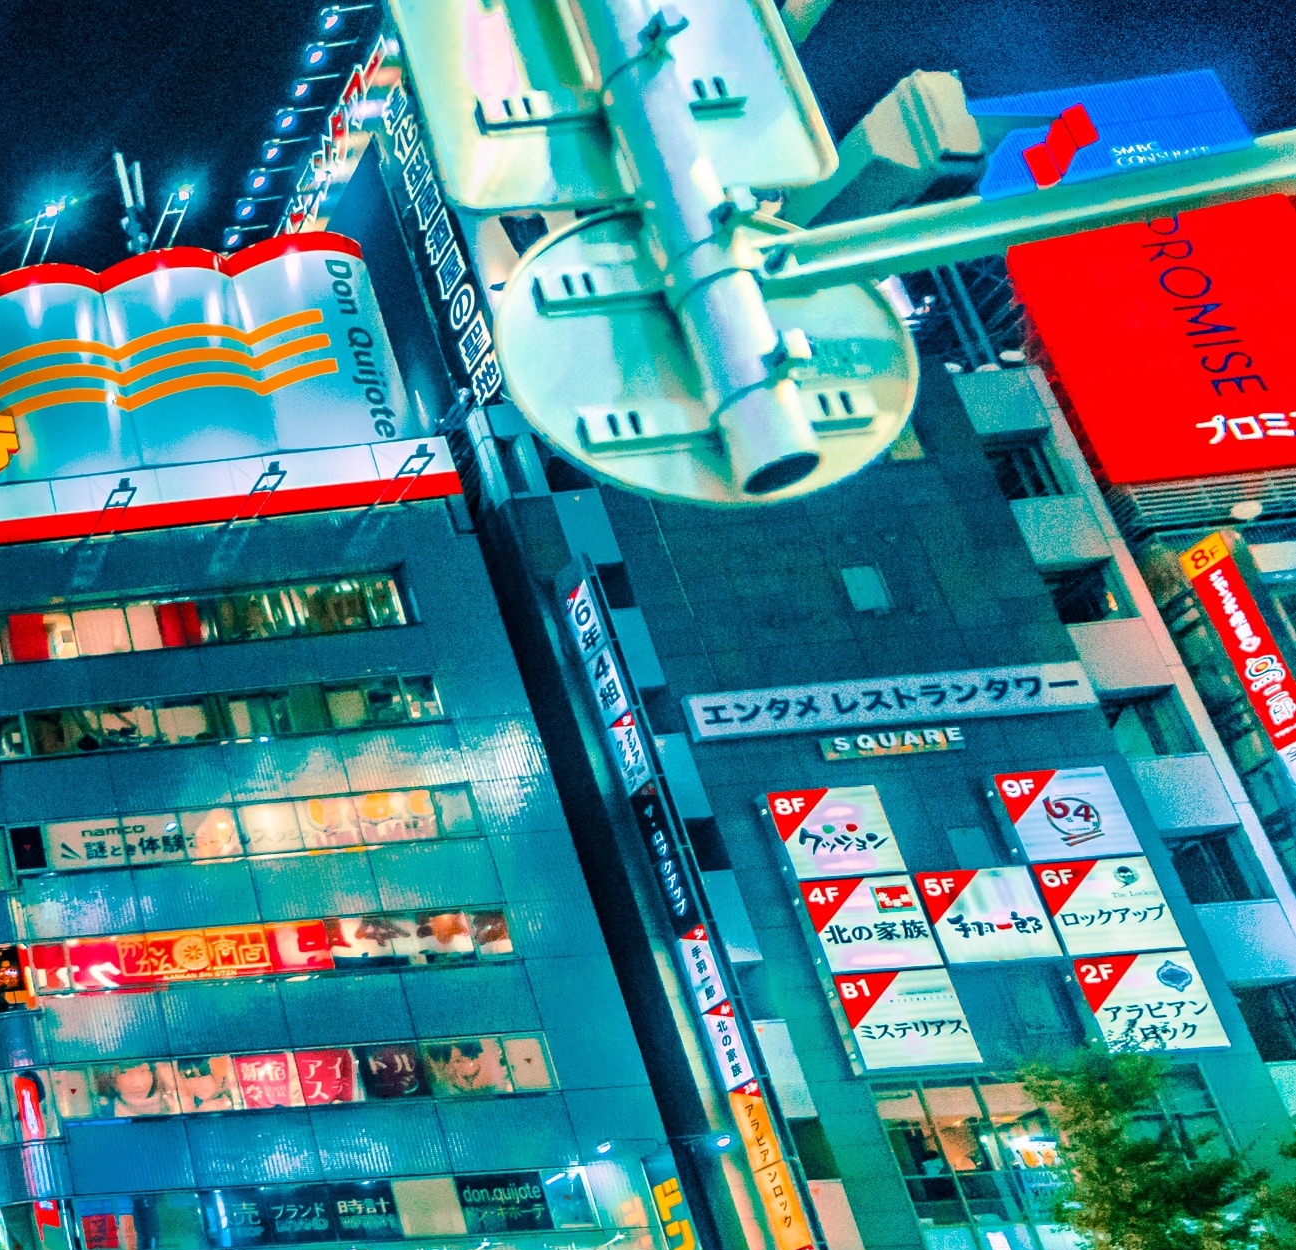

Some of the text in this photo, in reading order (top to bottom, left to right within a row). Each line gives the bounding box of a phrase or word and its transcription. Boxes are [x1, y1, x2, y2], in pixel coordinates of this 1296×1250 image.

[324, 259, 396, 439] Don Quijote
[1196, 412, 1296, 444] プロミ
[1191, 546, 1219, 570] 8F
[703, 675, 1079, 727] エンタメ レストランタワー
[833, 727, 965, 753] SQUARE
[1001, 779, 1036, 798] 9F
[775, 797, 805, 816] 8F
[82, 823, 146, 837] namco
[925, 878, 956, 897] 5F
[1041, 869, 1074, 889] 6F
[808, 887, 840, 906] 4F
[1061, 903, 1167, 927] ロックアップ
[824, 920, 929, 945] 北の家族
[1080, 965, 1114, 984] 2F
[841, 979, 871, 1000] B1
[1102, 1000, 1208, 1023] アラビアン
[860, 1020, 968, 1040] ミステリアス
[717, 1020, 743, 1077] 北の家族
[338, 1197, 391, 1214] 時計
